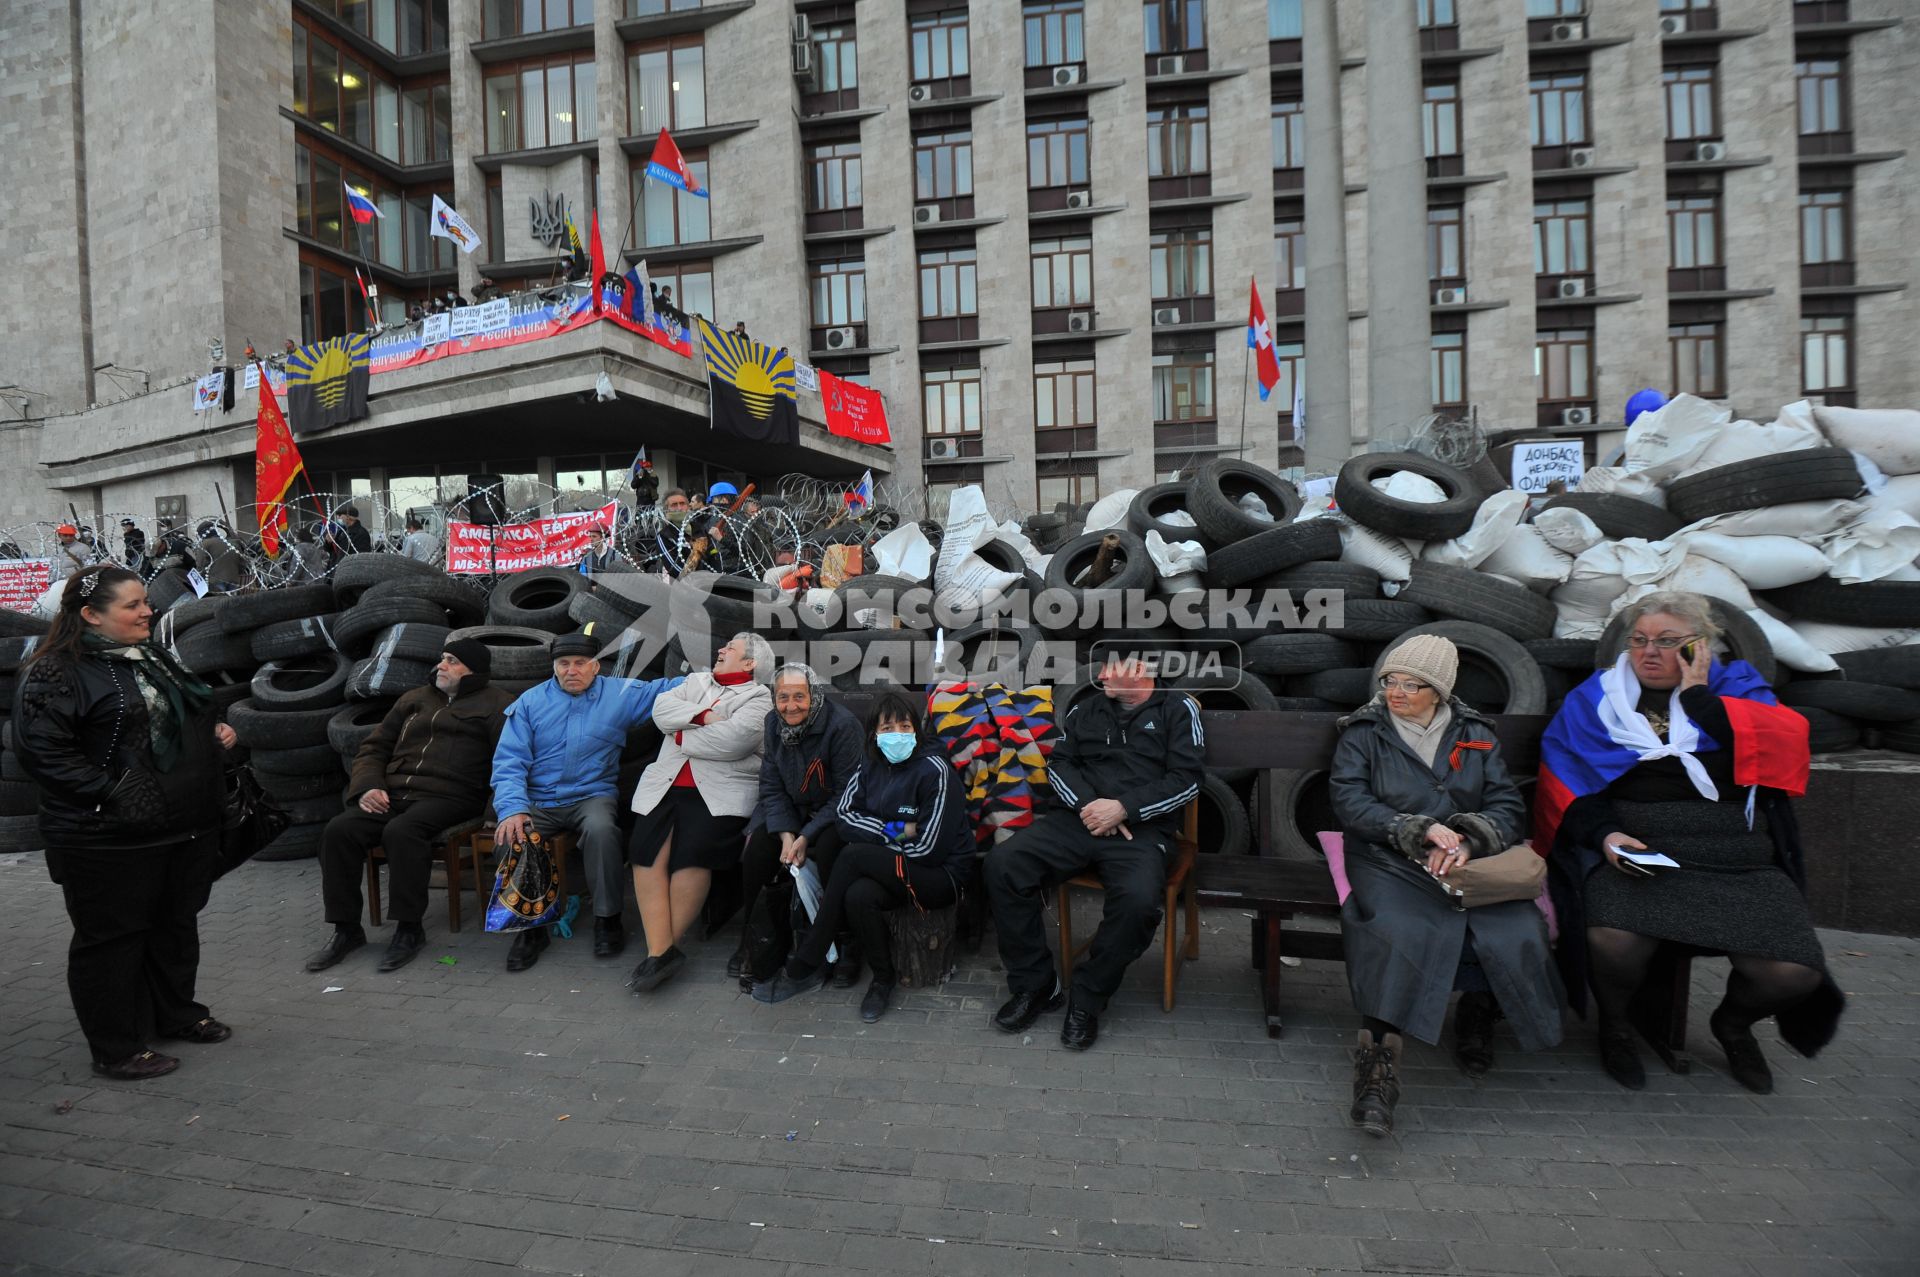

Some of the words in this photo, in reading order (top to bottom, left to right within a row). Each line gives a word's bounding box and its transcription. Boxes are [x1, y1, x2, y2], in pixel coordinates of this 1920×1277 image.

[370, 331, 417, 350] ОНЕЦКАЯ
[1525, 447, 1580, 463] ДОНБАСС
[541, 510, 606, 536] ЕВРОПА
